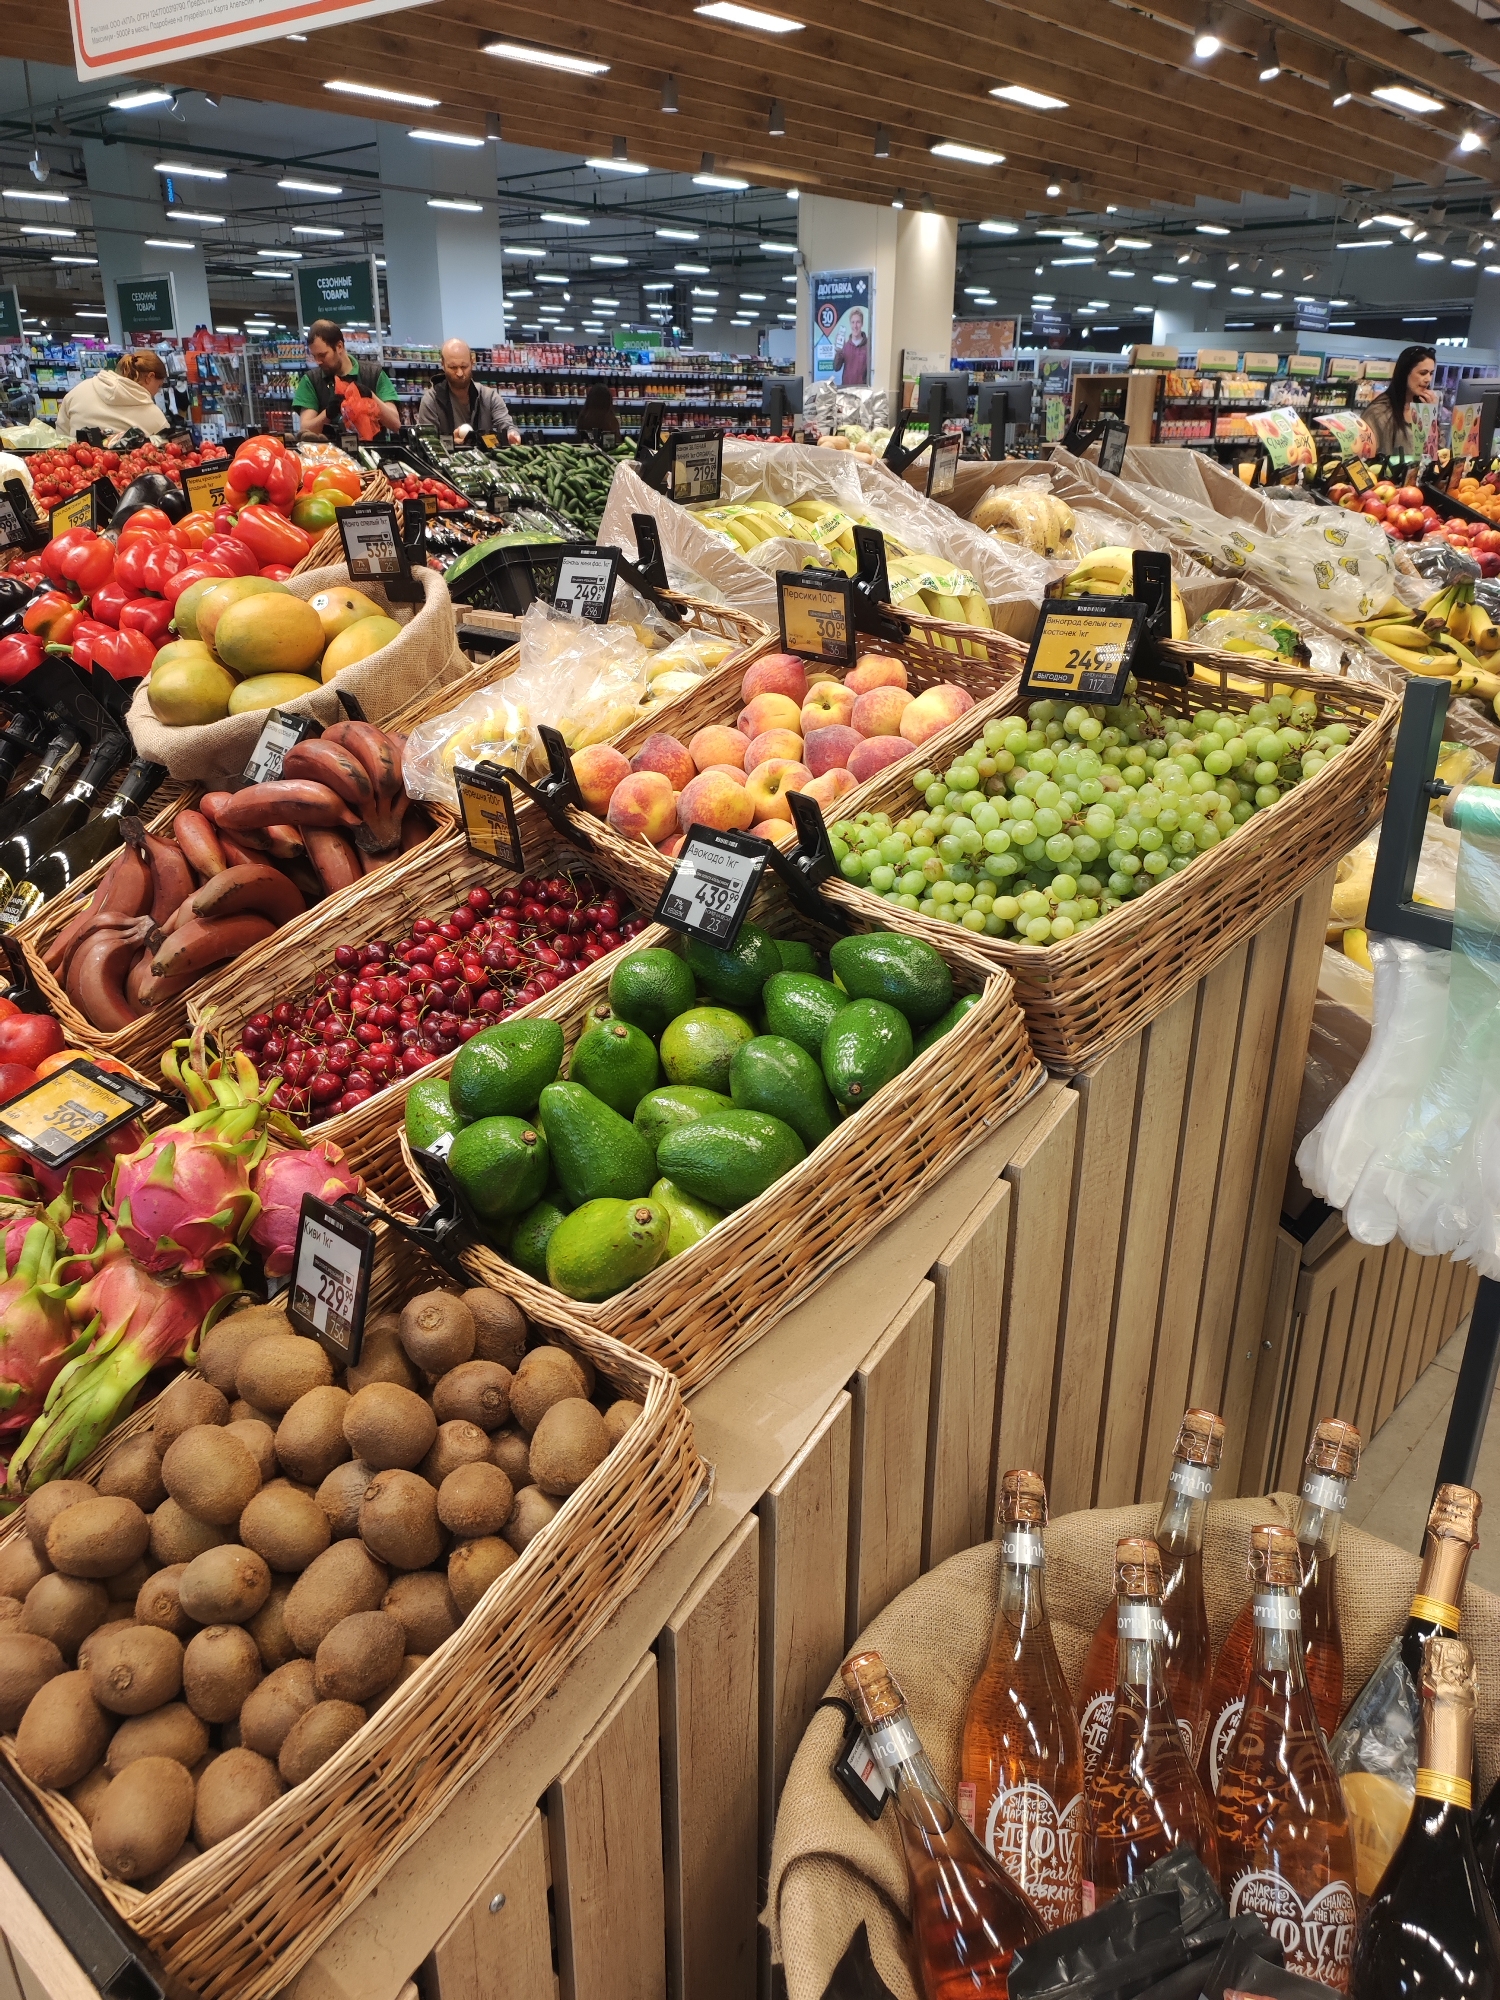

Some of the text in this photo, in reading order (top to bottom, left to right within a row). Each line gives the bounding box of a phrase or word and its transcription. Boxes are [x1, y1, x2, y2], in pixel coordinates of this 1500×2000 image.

[317, 276, 352, 288] СЕЗОННЫЕ
[131, 291, 157, 301] СЕЗОННЫЕ
[322, 289, 349, 300] ТОВАРЫ
[135, 303, 156, 311] ТОВАРЫ
[822, 310, 833, 322] 30
[694, 465, 710, 482] 219
[211, 493, 226, 507] 22
[0, 520, 12, 532] 99
[69, 513, 84, 528] 199
[342, 520, 359, 528] Манго
[361, 518, 379, 527] спелый
[366, 542, 387, 558] 539
[385, 562, 393, 571] 25
[891, 578, 910, 590] АНАН
[574, 584, 598, 600] 249
[784, 588, 836, 604] Персики 100г
[585, 606, 597, 615] 296
[816, 619, 845, 638] 30 00
[1046, 617, 1081, 626] Виноград
[1083, 619, 1107, 628] белый
[1043, 629, 1076, 637] косточек
[830, 644, 839, 655] 36
[1065, 649, 1106, 670] 249
[1037, 672, 1068, 682] ВЫГОДНО
[1089, 679, 1104, 691] 117
[264, 752, 281, 770] 219
[688, 844, 739, 869] Авокадо 1кг
[673, 898, 683, 910] 7%
[695, 883, 739, 910] 439 99
[706, 917, 721, 932] 23
[91, 1086, 121, 1106] КРУПНАЯ
[43, 1104, 96, 1132] 399 99
[46, 1137, 59, 1147] 3
[303, 1219, 333, 1248] Киви 1кг
[301, 1292, 309, 1308] 7%
[318, 1274, 353, 1312] 229 99
[330, 1319, 344, 1343] 756
[1009, 1794, 1038, 1810] SHARE
[1002, 1807, 1053, 1825] HAPPINESS
[1247, 1880, 1279, 1900] SHARE
[1241, 1891, 1297, 1917] HAPPINESS
[1312, 1907, 1328, 1922] THE
[1268, 1916, 1356, 1964] OVE
